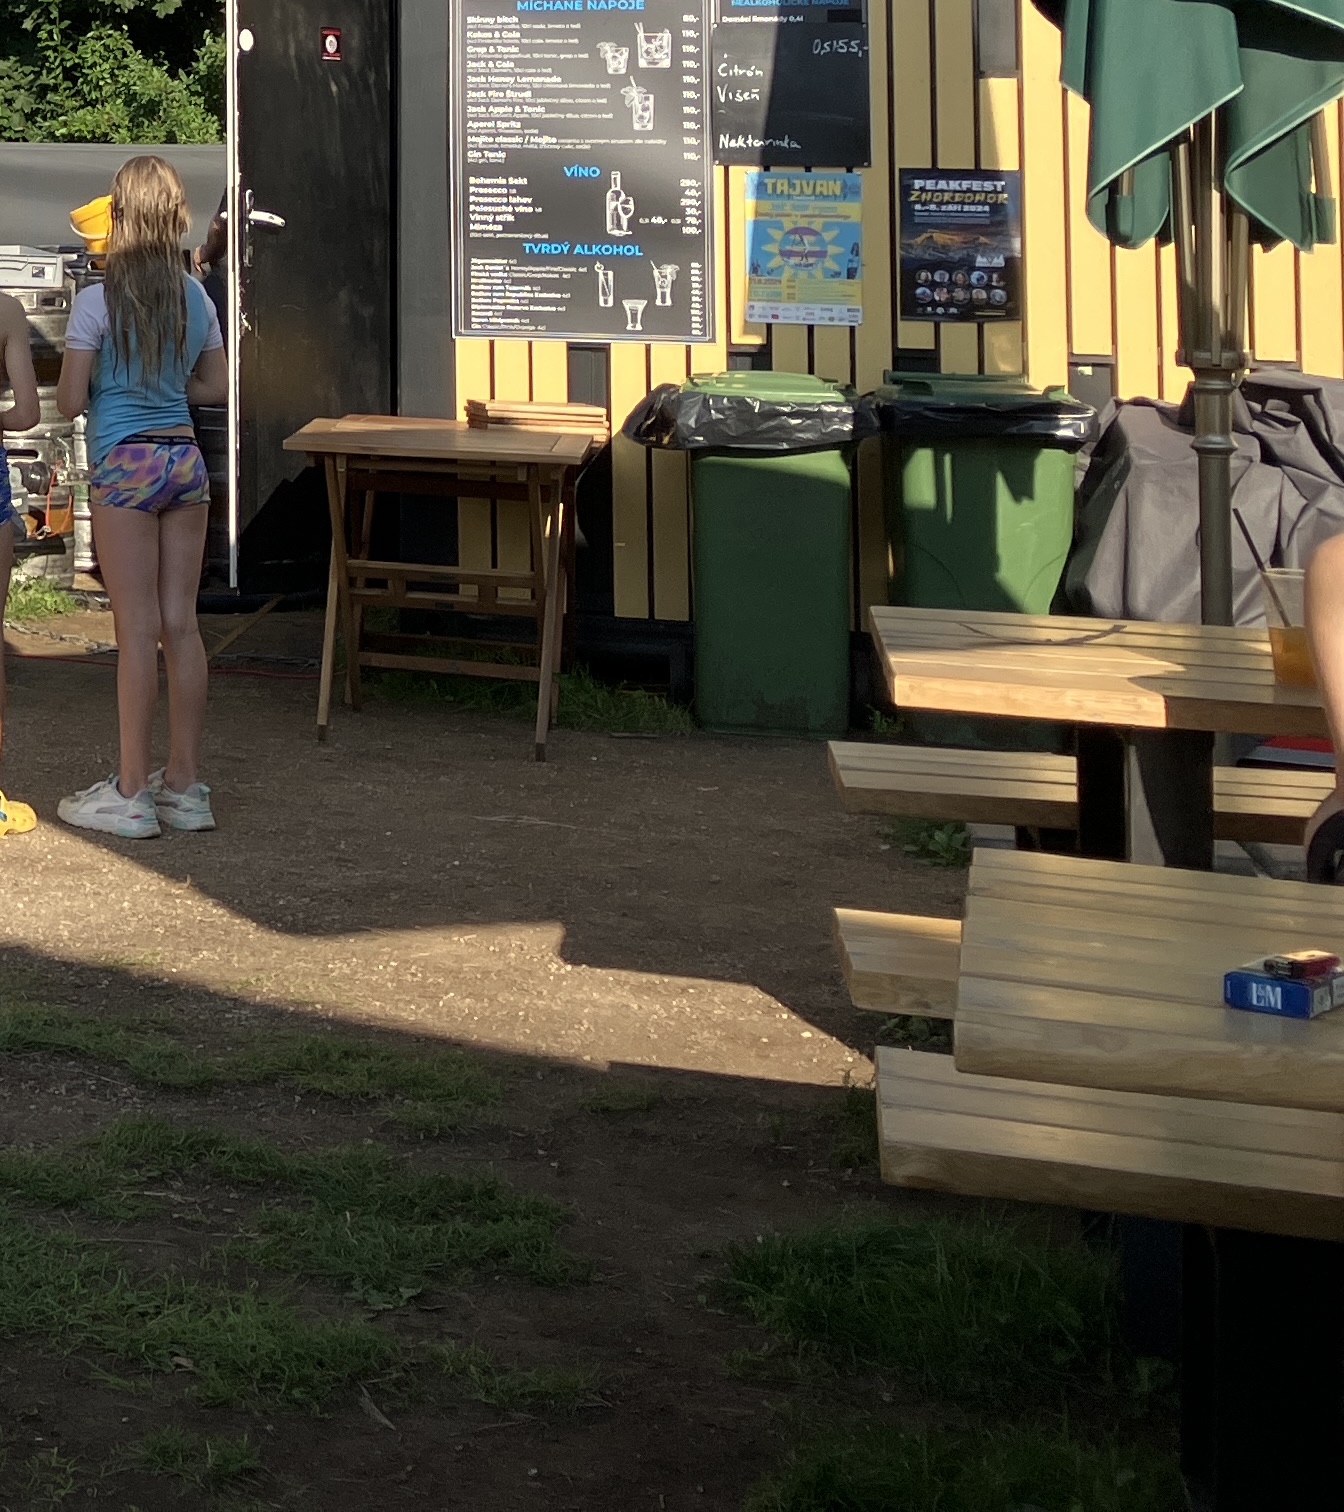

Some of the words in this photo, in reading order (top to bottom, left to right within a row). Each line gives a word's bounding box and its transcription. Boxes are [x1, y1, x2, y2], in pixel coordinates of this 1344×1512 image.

[496, 15, 519, 24] bitch
[496, 45, 519, 53] Tonic
[496, 60, 515, 68] Cola
[467, 75, 486, 83] Jack
[488, 75, 515, 84] Honey
[467, 90, 486, 98] Jack
[488, 90, 504, 98] Fire
[488, 105, 513, 114] Apple
[522, 105, 545, 113] Tonic
[467, 121, 495, 129] Aperol
[483, 150, 506, 158] Tonic
[563, 164, 601, 178] VÍNO
[764, 178, 843, 196] TAJVAN
[914, 179, 1006, 192] PEAKFEST
[522, 241, 571, 255] TVRDÝ
[573, 244, 644, 257] ALKOHOL
[1251, 982, 1282, 1010] L&M
